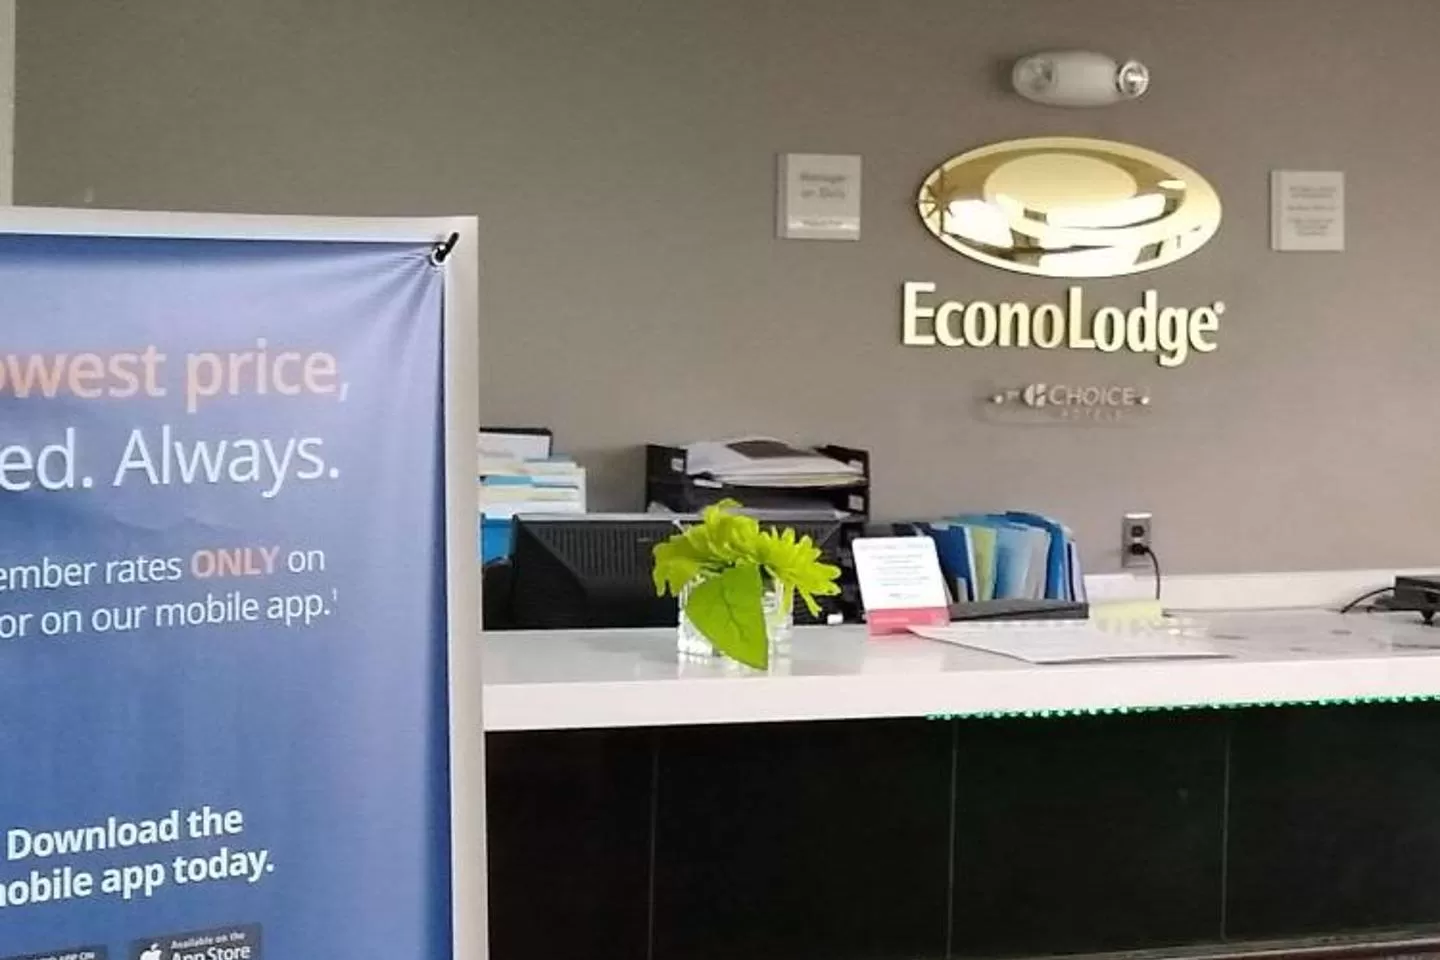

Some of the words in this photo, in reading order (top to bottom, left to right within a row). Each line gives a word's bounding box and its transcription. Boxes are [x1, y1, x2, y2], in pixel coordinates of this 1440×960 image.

[0, 345, 168, 399] west
[187, 338, 348, 413] price,
[1050, 384, 1136, 407] CHOICE
[113, 426, 340, 498] Always.
[106, 554, 183, 585] rates
[191, 546, 281, 580] ONLY
[287, 549, 326, 574] on
[41, 609, 82, 635] on
[92, 602, 147, 632] our
[156, 593, 260, 627] mobile
[7, 810, 181, 861] Download
[187, 806, 244, 838] the
[0, 866, 93, 906] obile
[101, 860, 165, 899] app
[173, 848, 275, 885] today.
